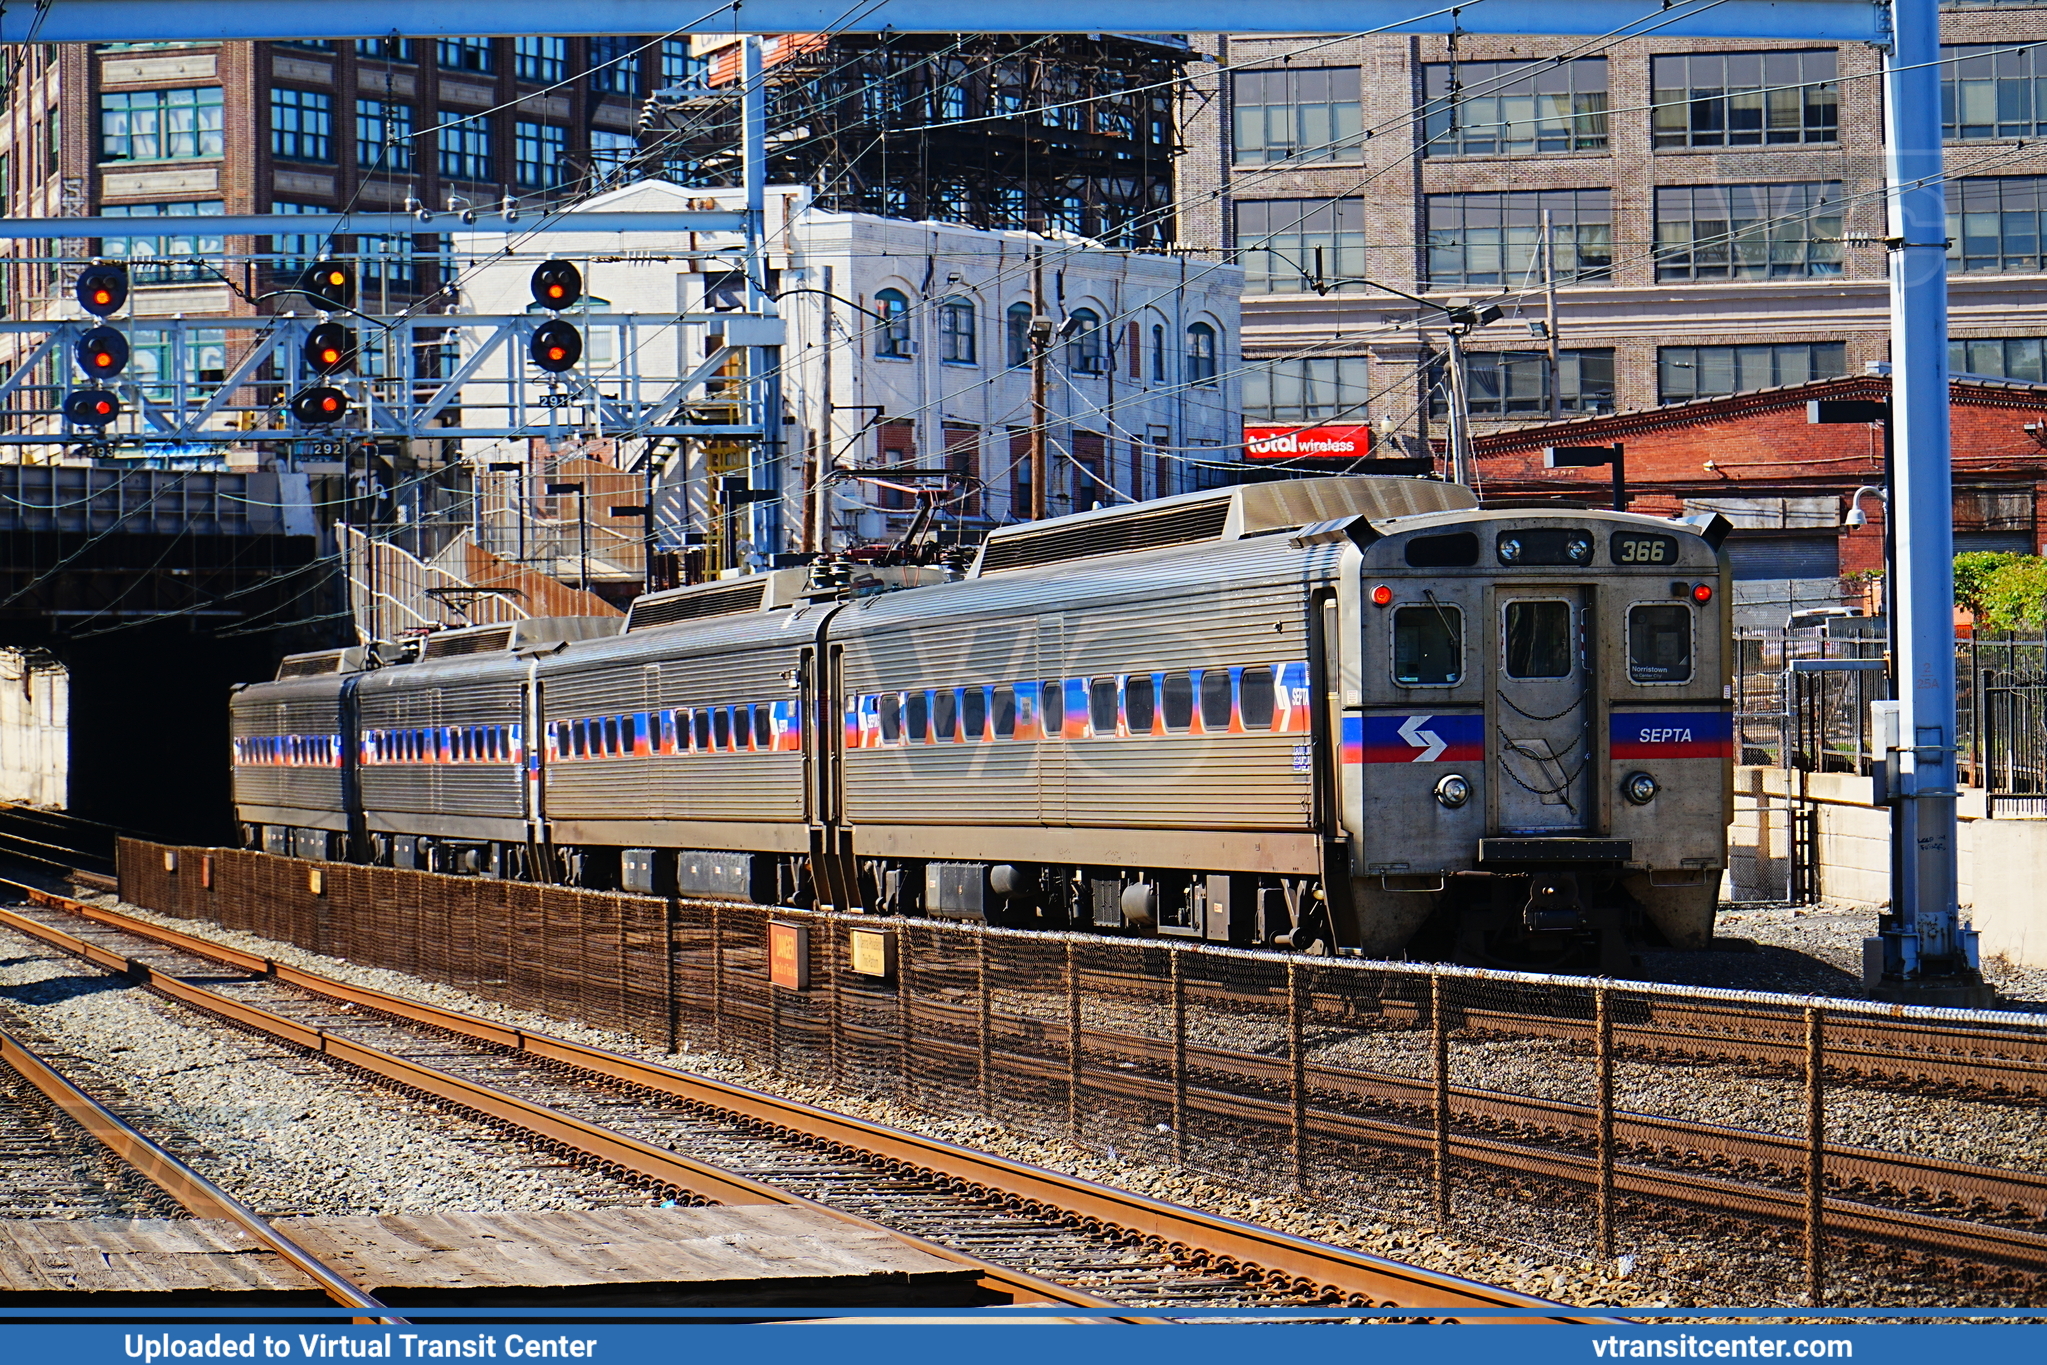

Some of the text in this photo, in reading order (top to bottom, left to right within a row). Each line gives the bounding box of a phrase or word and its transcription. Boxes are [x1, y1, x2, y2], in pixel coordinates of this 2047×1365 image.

[314, 444, 341, 454] 292
[1248, 433, 1355, 453] total wireless
[88, 447, 114, 457] 293
[1621, 541, 1665, 561] 366
[1632, 665, 1668, 673] Norristown
[1292, 687, 1310, 705] SEPTA
[1639, 728, 1692, 743] SEPTA
[776, 933, 795, 960] DANGER
